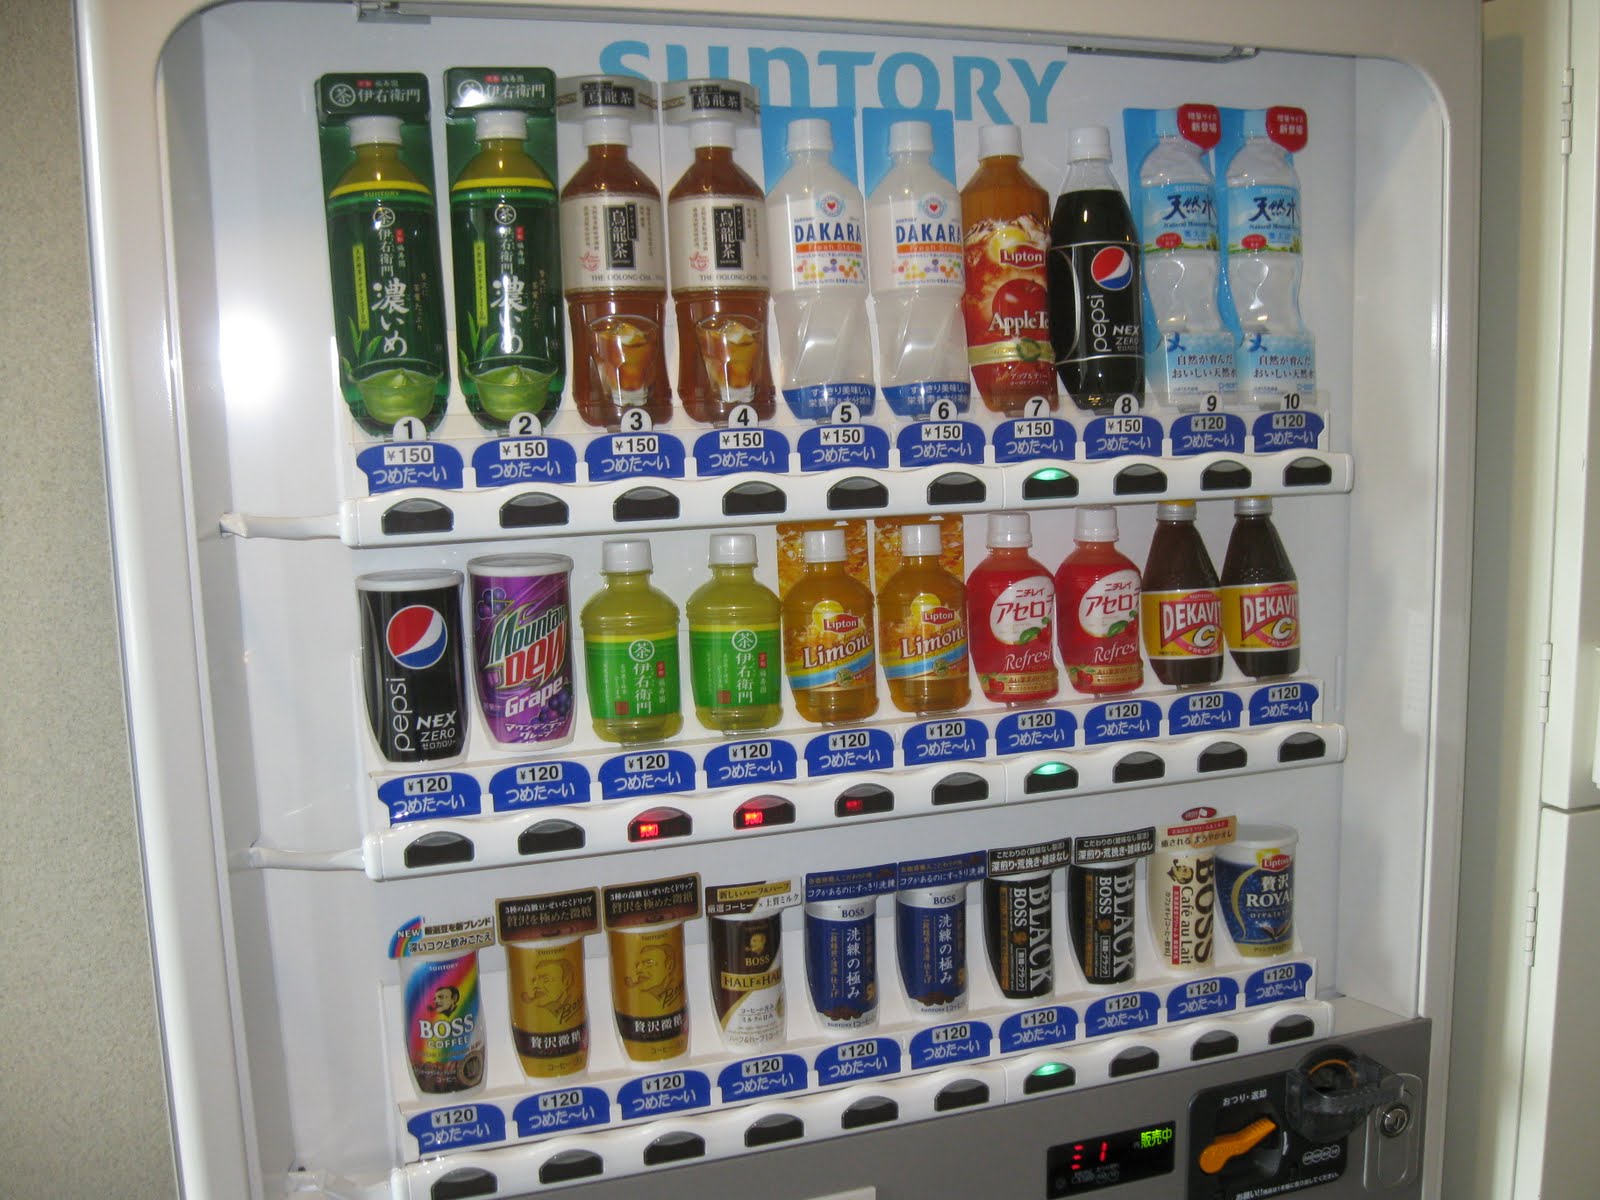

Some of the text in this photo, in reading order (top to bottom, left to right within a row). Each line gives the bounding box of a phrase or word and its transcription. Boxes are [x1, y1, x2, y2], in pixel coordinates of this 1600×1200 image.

[358, 88, 421, 103] 伊右衛門
[486, 83, 546, 99] 伊右衛門
[612, 209, 628, 259] 烏龍茶
[719, 210, 736, 259] 烏龍茶
[794, 222, 862, 243] DAKARA
[379, 228, 394, 277] 伊右衛門
[1003, 251, 1042, 264] Lipton
[371, 277, 410, 357] 濃いめ
[988, 309, 1038, 336] Apple
[1087, 294, 1112, 353] pepsi
[1112, 325, 1140, 336] NEX
[1115, 337, 1139, 346] ZERO
[1031, 399, 1043, 417] 7
[1121, 397, 1132, 415] 8
[1207, 395, 1217, 412] 9
[1283, 393, 1300, 410] 10
[737, 408, 750, 427] 4
[840, 405, 852, 423] 5
[937, 401, 950, 420] 6
[518, 415, 532, 435] 2
[630, 412, 643, 431] 3
[1016, 422, 1052, 436] ¥150
[1107, 419, 1141, 433] ¥150
[1194, 417, 1224, 430] ¥120
[1275, 414, 1304, 428] ¥120
[403, 420, 413, 440] 1
[822, 429, 861, 444] ¥150
[924, 425, 961, 440] ¥150
[615, 437, 656, 453] ¥150
[722, 432, 762, 448] ¥150
[387, 447, 432, 464] ¥150
[502, 441, 546, 458] ¥150
[1016, 588, 1045, 599] ニチレイ
[1105, 581, 1133, 592] ニチレイ
[924, 611, 953, 621] Lipton
[826, 619, 857, 632] Lipton
[1271, 617, 1293, 640] C
[1193, 624, 1217, 648] C
[803, 630, 872, 669] Limone
[736, 652, 754, 704] 伊右衛門
[505, 675, 563, 718] Grape
[633, 663, 653, 714] 伊右衛門
[1271, 686, 1299, 700] ¥120
[1191, 695, 1221, 709] ¥120
[386, 677, 416, 752] pepsi
[416, 709, 457, 730] NEX
[1108, 704, 1139, 718] ¥120
[1020, 713, 1053, 728] ¥120
[421, 727, 455, 744] ZERO
[929, 722, 963, 737] ¥120
[832, 733, 867, 748] ¥120
[732, 744, 768, 759] ¥120
[628, 754, 666, 770] ¥120
[520, 765, 559, 782] ¥120
[407, 777, 448, 793] ¥120
[1264, 857, 1289, 868] Lipton
[933, 894, 957, 905] BOSS
[1099, 876, 1112, 915] BOSS
[841, 907, 865, 918] BOSS
[1013, 888, 1027, 927] BOSS
[1194, 858, 1215, 964] BOSS
[397, 929, 422, 938] NEW
[1113, 875, 1135, 978] BLACK
[1181, 886, 1194, 966] Café au Lait
[1028, 886, 1053, 991] BLACK
[938, 914, 953, 985] 洗練の極み
[428, 962, 459, 971] SUNTORY
[744, 955, 770, 966] BOSS
[846, 927, 861, 999] 洗練の極み
[1266, 967, 1293, 981] ¥120
[1188, 981, 1218, 995] ¥120
[1108, 996, 1138, 1011] ¥120
[419, 1013, 475, 1039] BOSS
[1023, 1011, 1055, 1026] ¥120
[935, 1026, 968, 1041] ¥120
[428, 1035, 470, 1050] COFFEE
[841, 1042, 875, 1058] ¥120
[744, 1058, 780, 1074] ¥120
[644, 1074, 682, 1091] ¥120
[541, 1091, 580, 1108] ¥120
[434, 1108, 474, 1125] ¥120
[1140, 1127, 1173, 1148] 販売中
